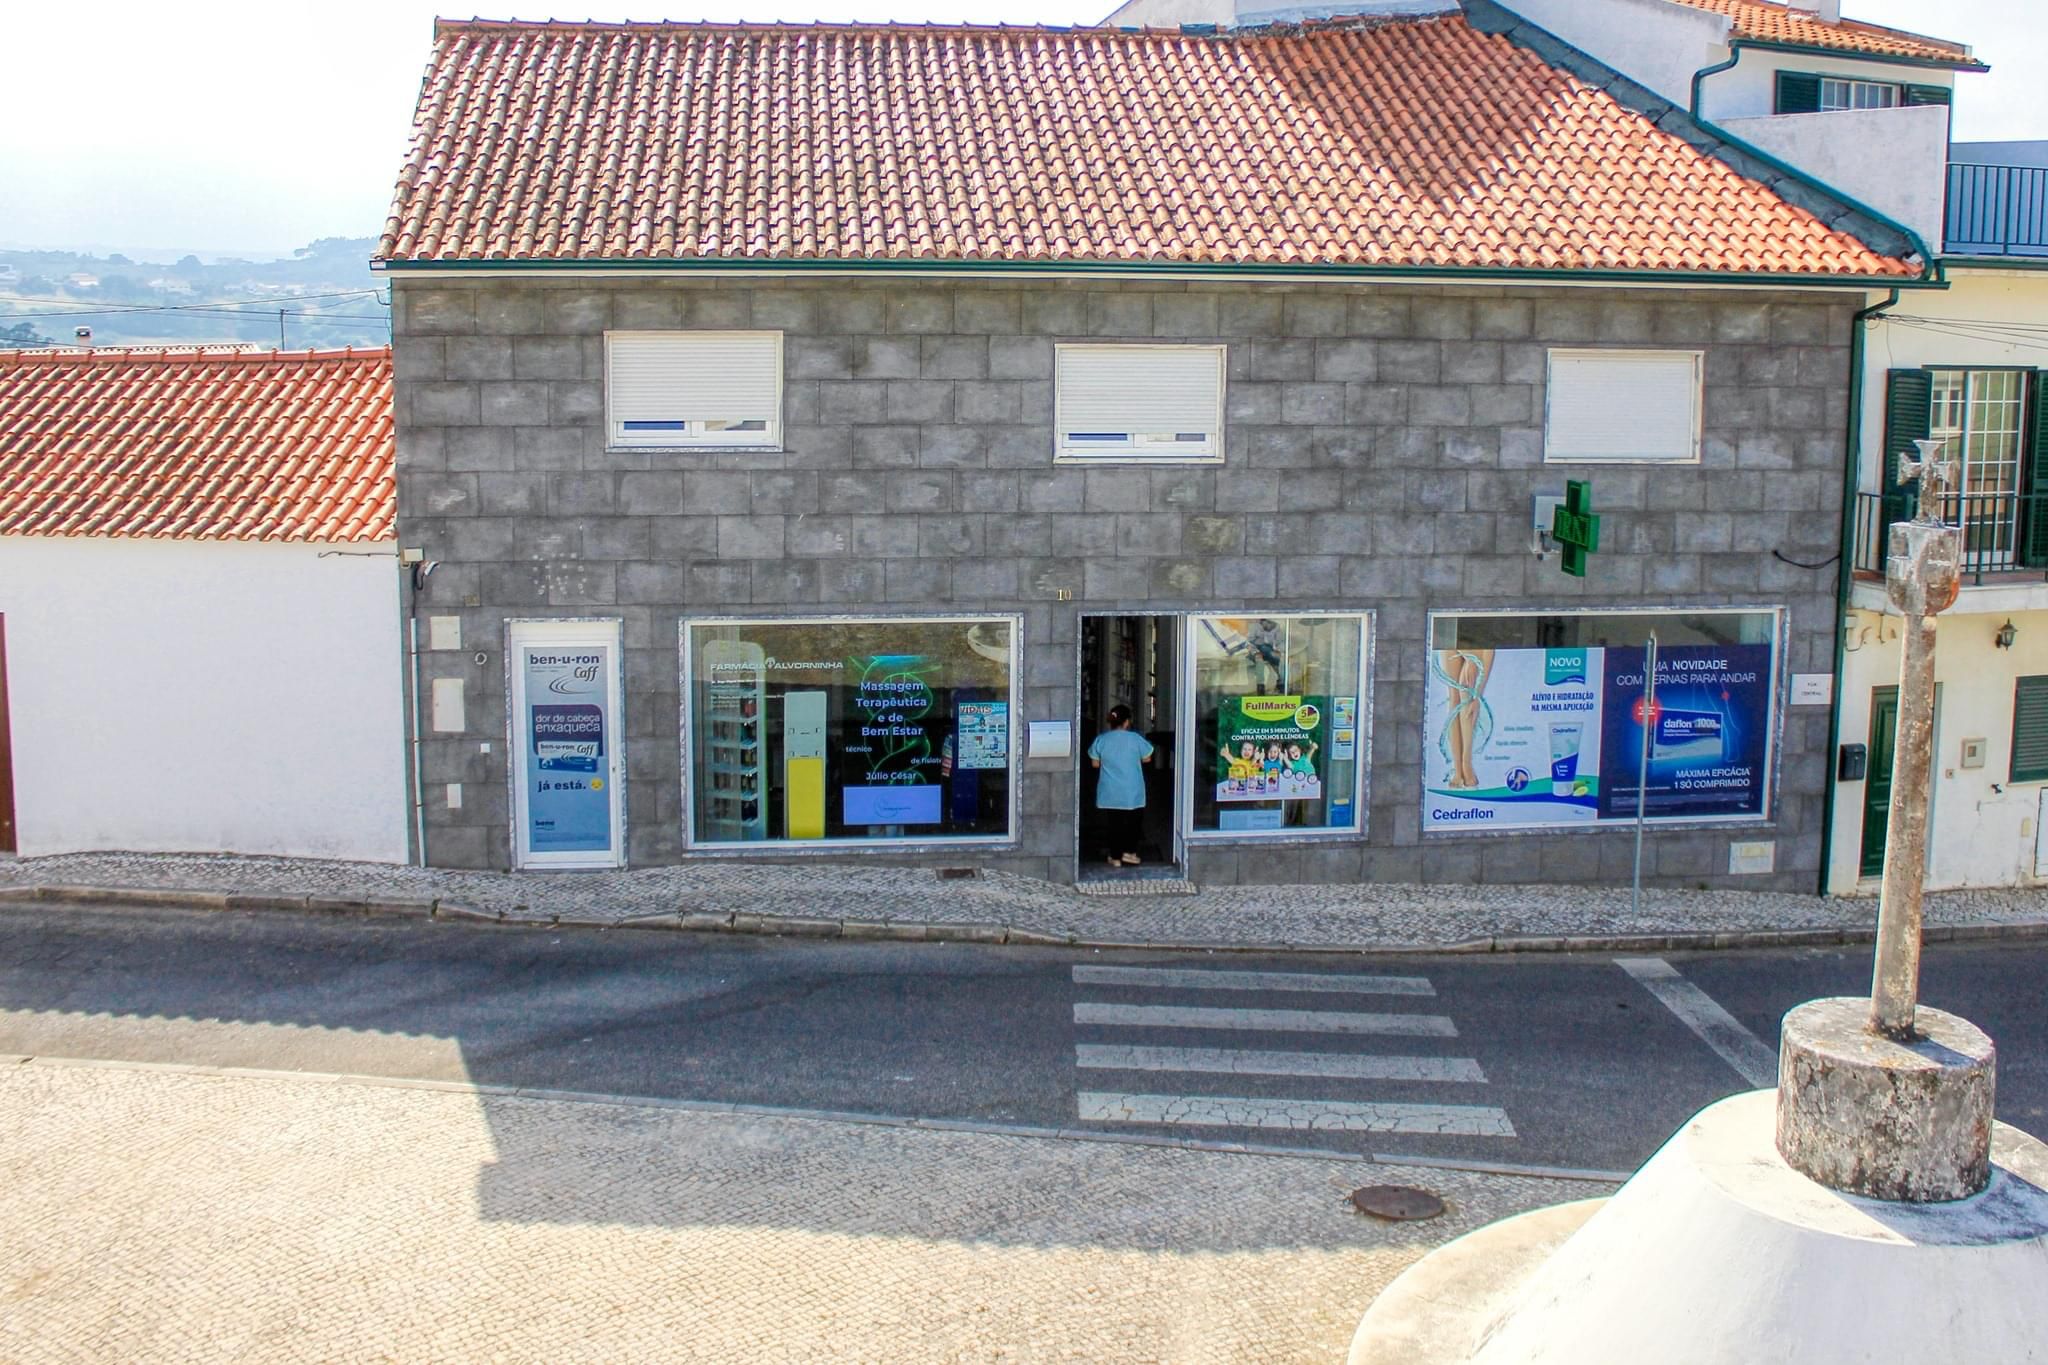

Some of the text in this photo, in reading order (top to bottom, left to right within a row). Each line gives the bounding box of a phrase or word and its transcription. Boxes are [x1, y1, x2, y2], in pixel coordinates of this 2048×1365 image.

[1057, 589, 1072, 601] 10
[530, 654, 600, 664] ben-u-ron
[1550, 657, 1581, 667] NOVO
[710, 661, 844, 671] FARMÁCIA ALVORNINHA
[1672, 660, 1728, 671] NOVIDADE
[574, 666, 599, 682] Caff
[1616, 672, 1756, 686] COM ERNAS PARA ANDAR
[860, 682, 924, 692] Massagem
[1532, 691, 1594, 701] ALÍVIO E HIDRATAÇÃO
[856, 697, 927, 709] Terapêutica
[1245, 702, 1297, 711] FullMarks
[1531, 702, 1594, 712] NA MESMA APLICAÇÃO
[535, 713, 600, 725] dor de cabeça
[877, 712, 904, 722] e de
[1301, 709, 1308, 718] 5
[535, 722, 601, 735] enxaqueca
[1664, 718, 1692, 729] daflon
[861, 726, 924, 736] Bem Estar
[576, 743, 595, 756] Caff
[845, 744, 873, 753] técnico
[866, 771, 917, 781] Júlio César
[1675, 765, 1751, 778] MÁXIMA EFICÁCIA
[538, 780, 587, 793] já está.
[1680, 778, 1692, 789] SÓ
[1693, 778, 1751, 789] COMPRIMIDO
[1432, 808, 1494, 821] Cedraflon
